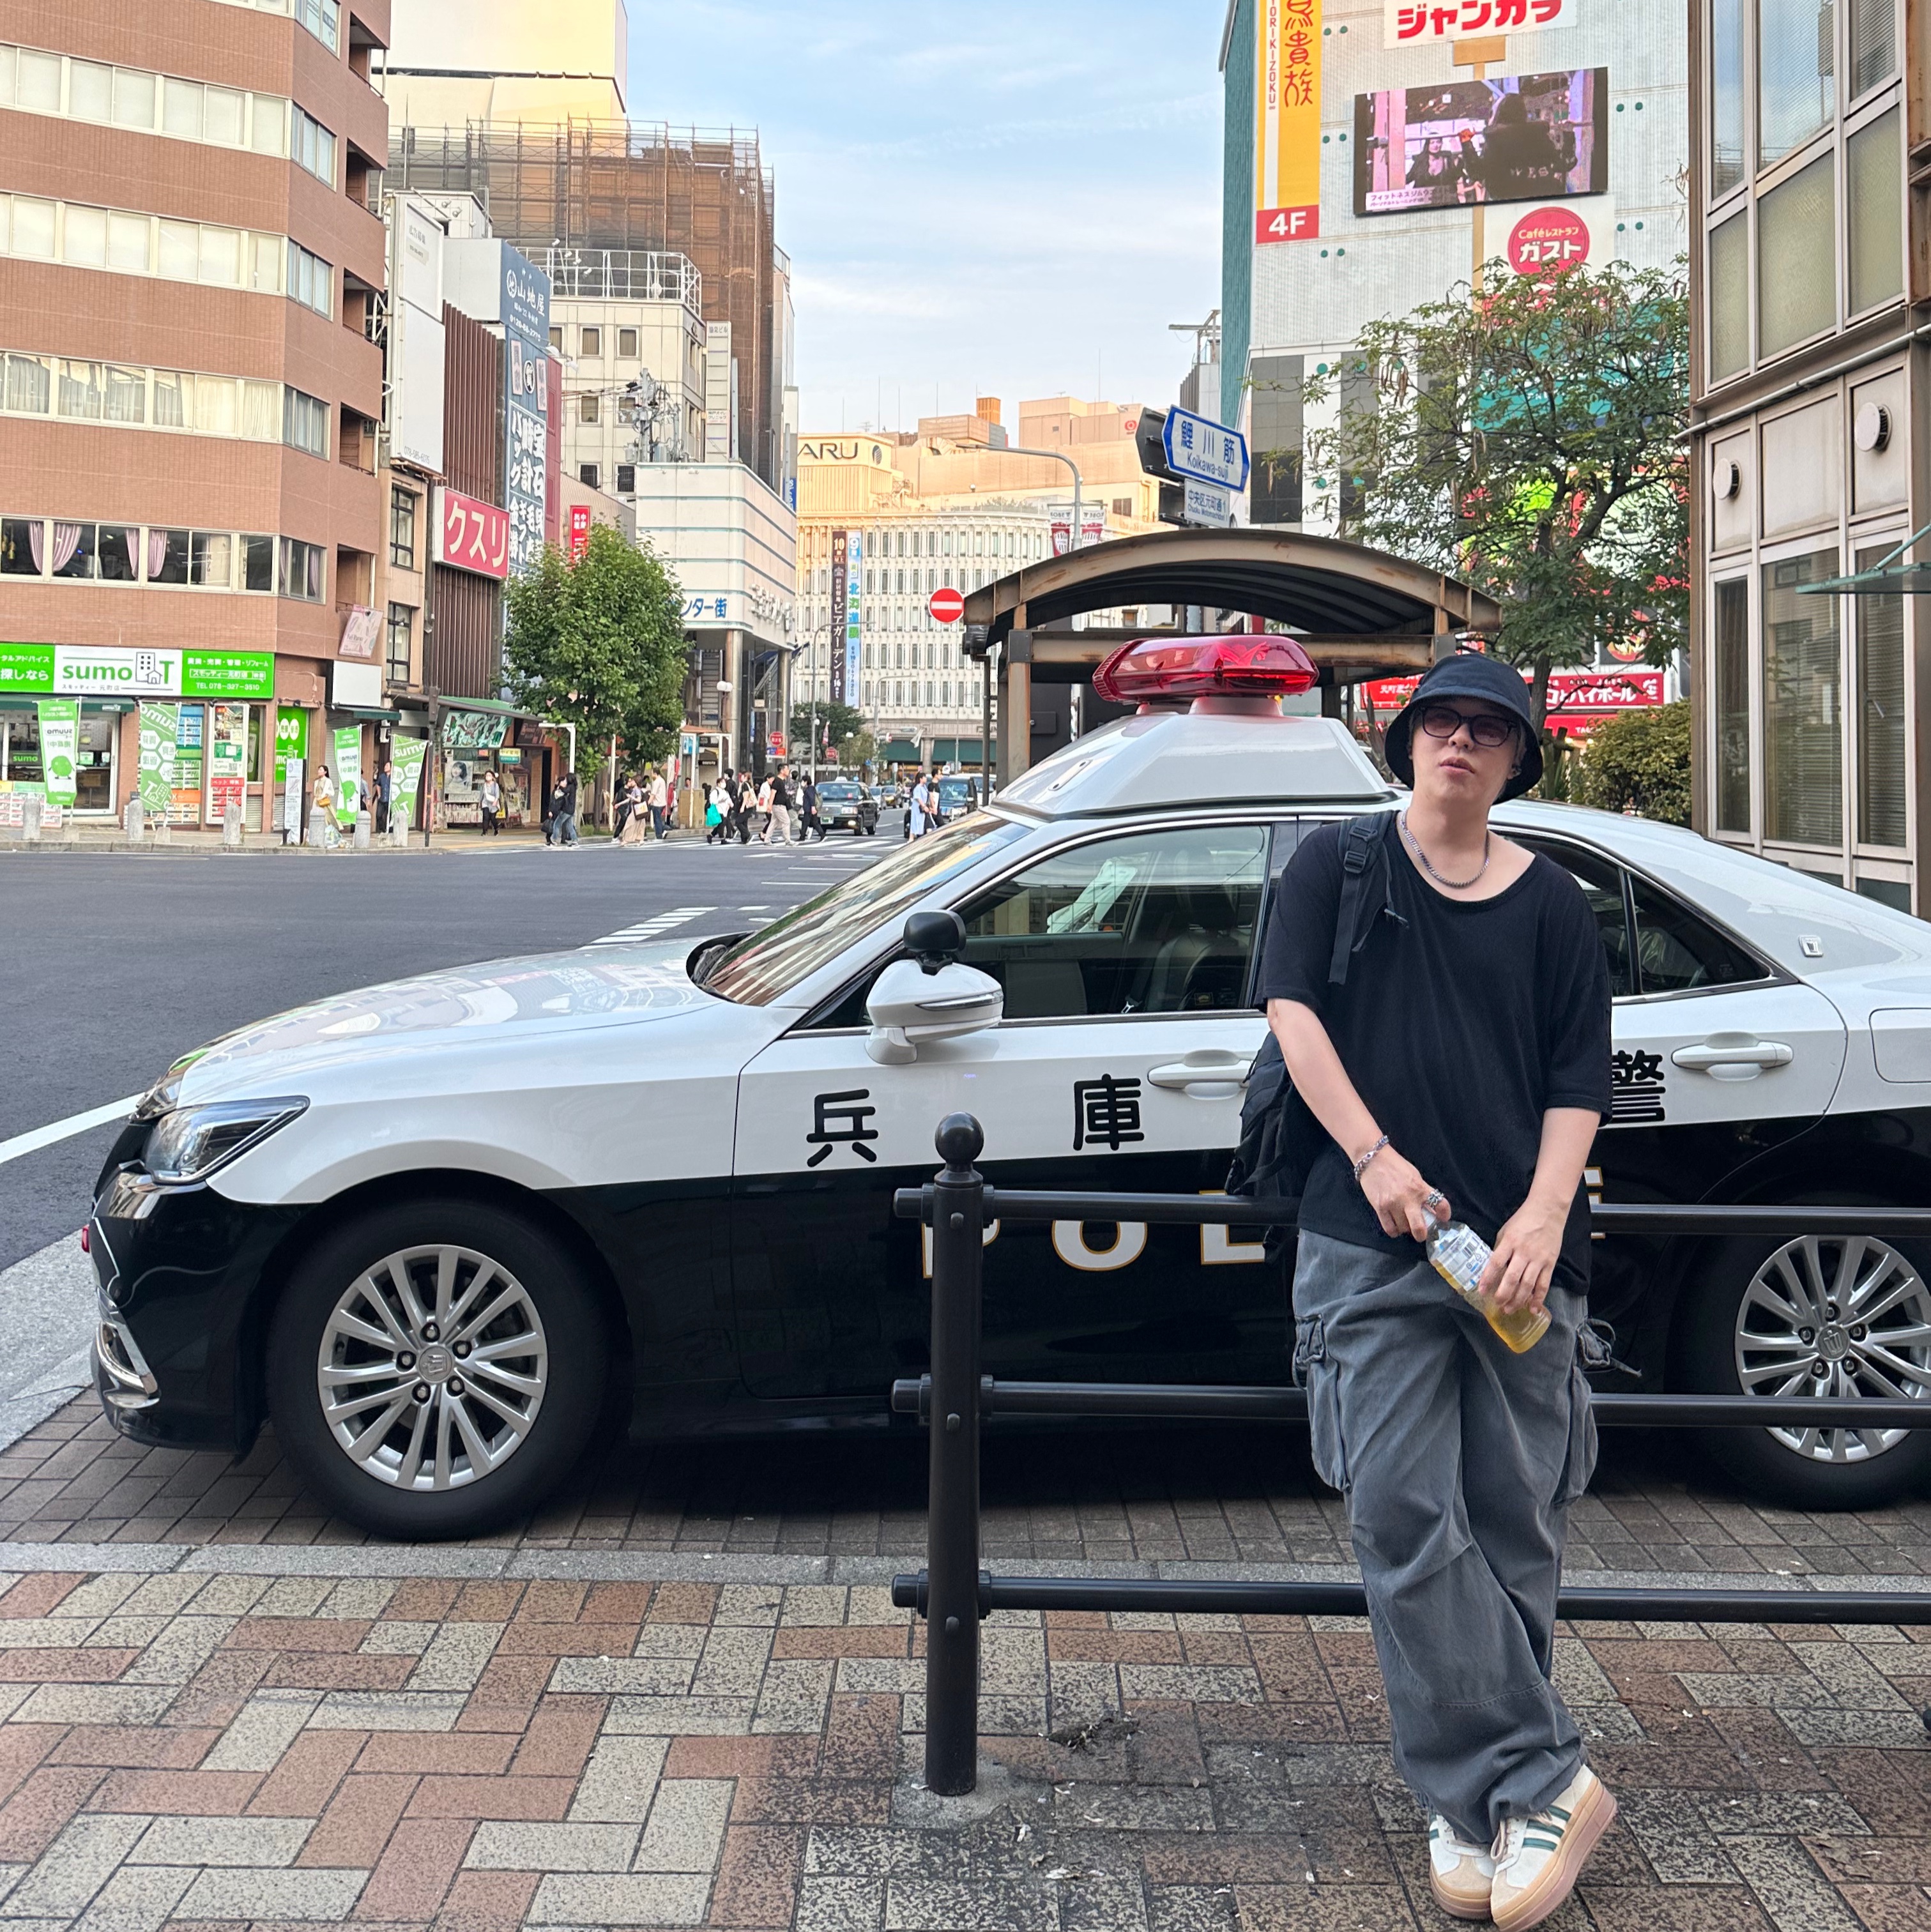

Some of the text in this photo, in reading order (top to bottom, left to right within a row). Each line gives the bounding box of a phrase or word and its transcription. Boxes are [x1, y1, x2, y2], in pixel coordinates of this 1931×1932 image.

[1398, 0, 1562, 39] ジャンカラ
[1285, 0, 1313, 107] 鳥貴族
[1269, 211, 1306, 236] 4F
[1519, 240, 1582, 263] ガスト
[517, 280, 546, 317] 山地屋
[532, 423, 545, 499] 宝石
[1187, 451, 1229, 482] Koikawa-suji
[446, 500, 507, 568] クスリ
[666, 597, 728, 619] ンター街
[62, 660, 175, 685] sumo T
[13, 754, 39, 763] sumo
